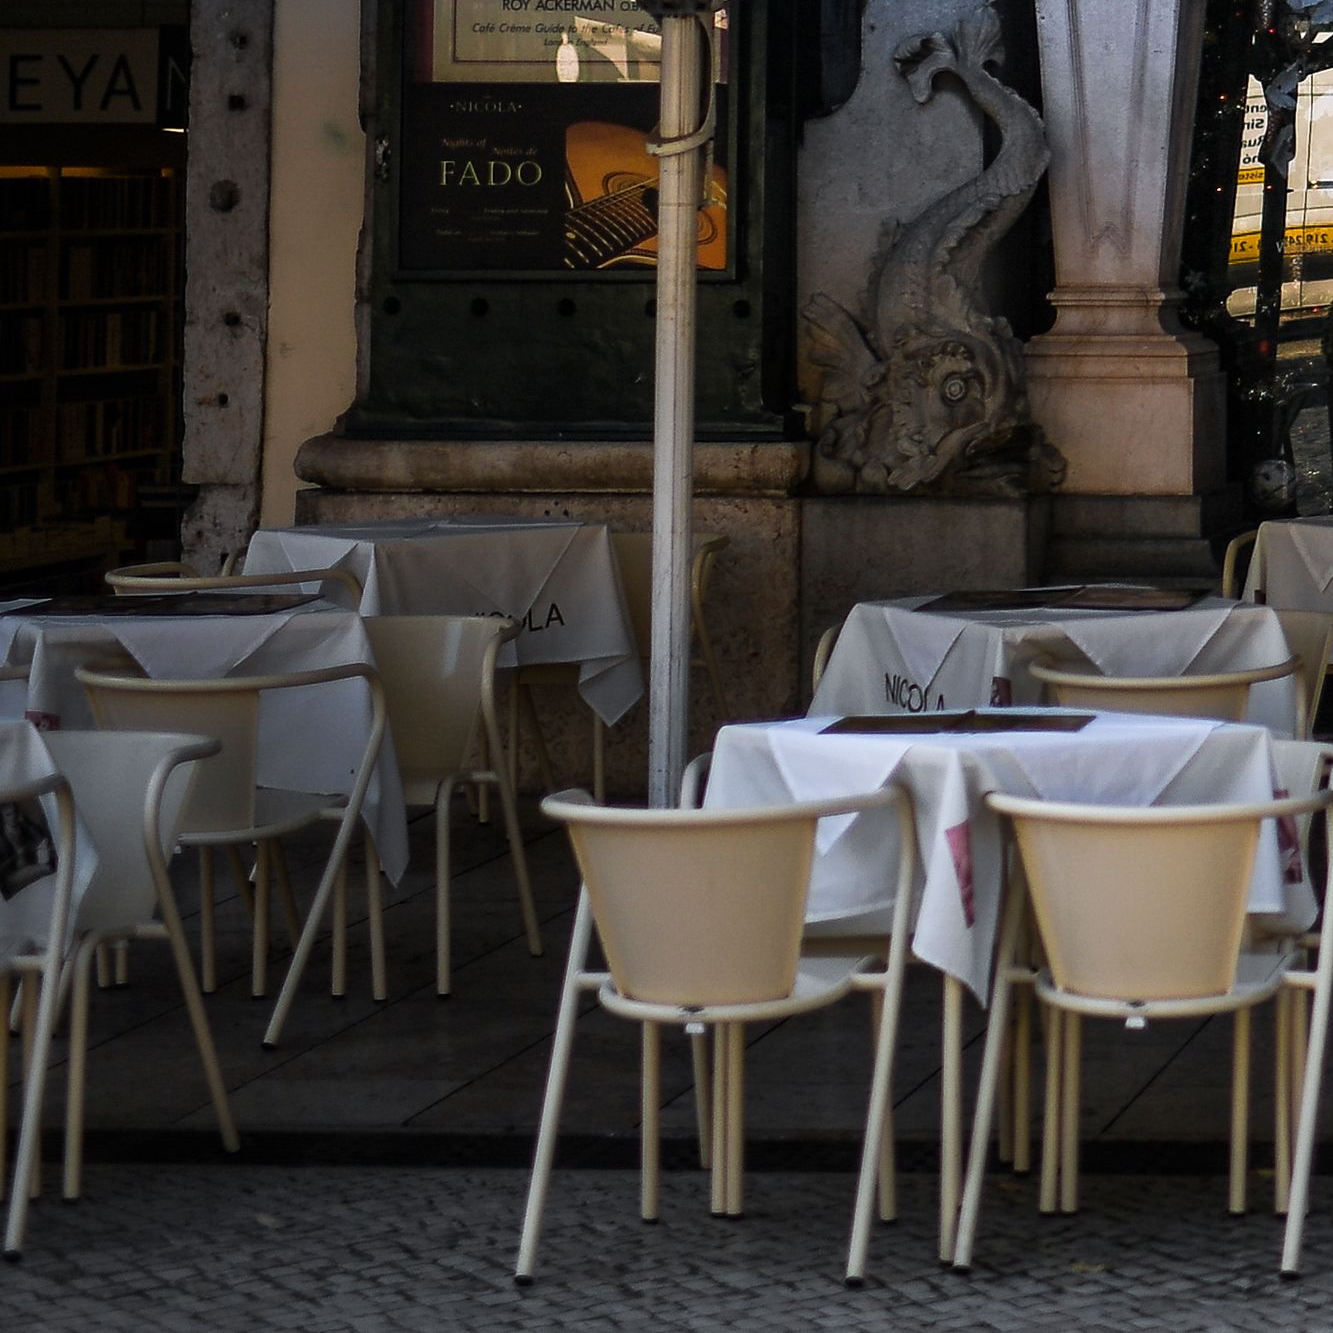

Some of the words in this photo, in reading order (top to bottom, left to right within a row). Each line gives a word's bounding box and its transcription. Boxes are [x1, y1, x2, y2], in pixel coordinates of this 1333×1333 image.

[472, 22, 496, 34] Café
[535, 22, 565, 34] Guide
[567, 24, 578, 34] to
[439, 160, 543, 187] FADO
